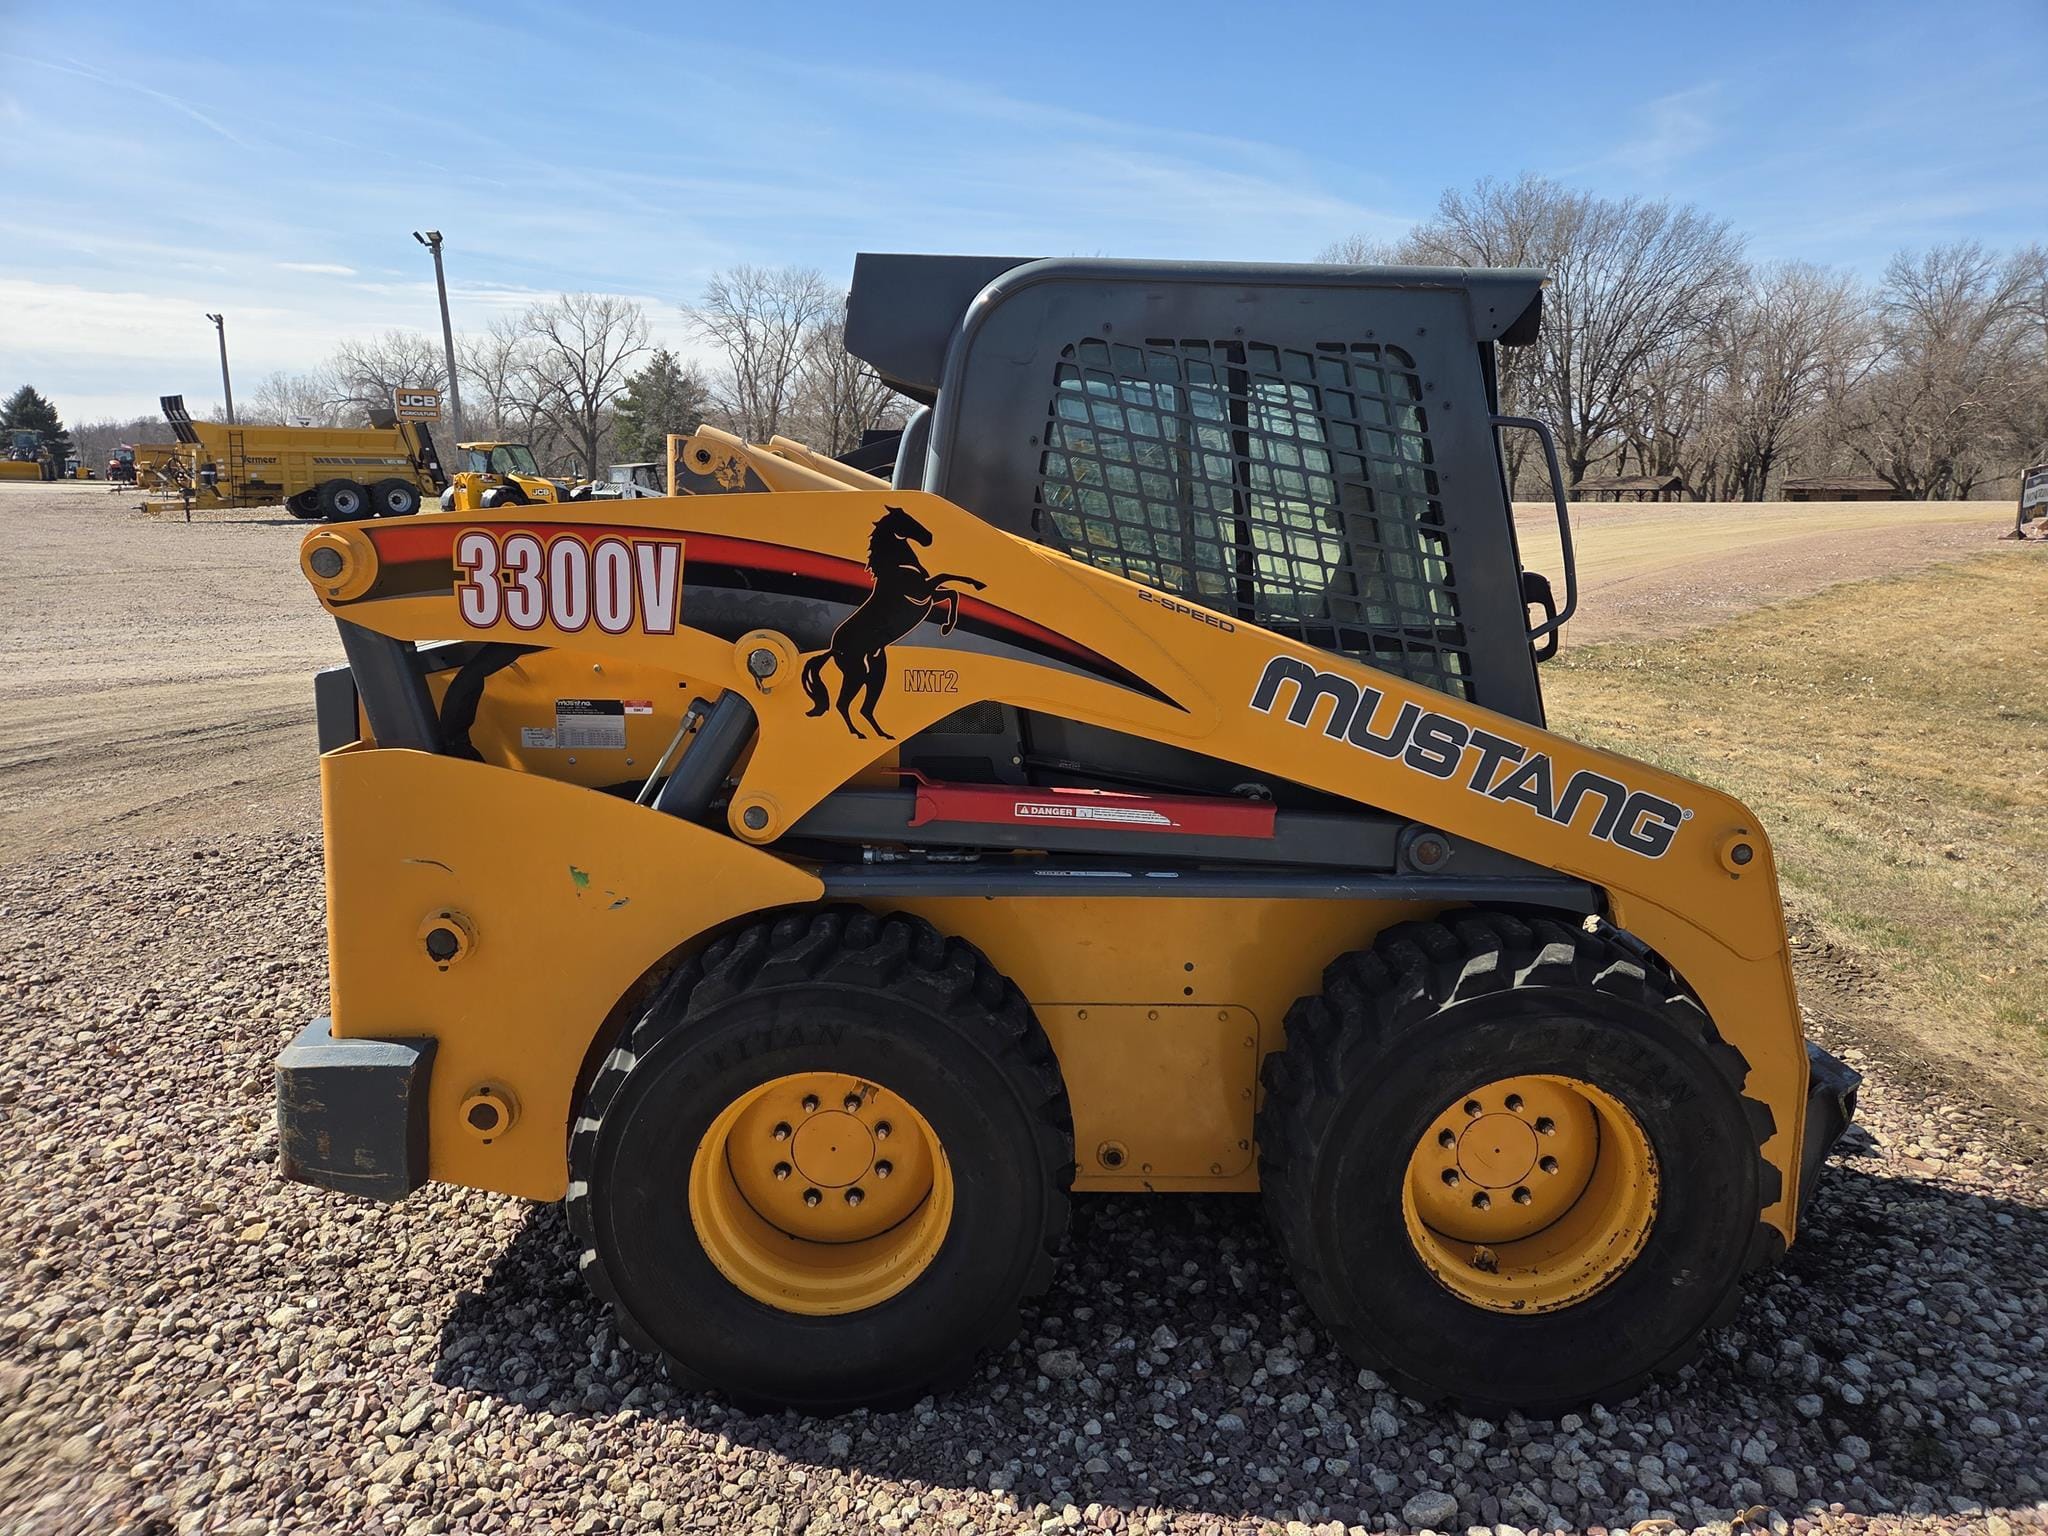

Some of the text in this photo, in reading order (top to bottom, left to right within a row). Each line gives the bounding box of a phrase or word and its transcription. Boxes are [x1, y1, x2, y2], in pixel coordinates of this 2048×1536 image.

[399, 395, 436, 406] JCB
[533, 488, 549, 496] JCB
[457, 532, 683, 635] 3300V
[1138, 589, 1235, 633] 2-SPEED
[904, 669, 959, 693] NXT2
[1250, 654, 1684, 859] MUSTANG
[1031, 807, 1073, 816] DANGER
